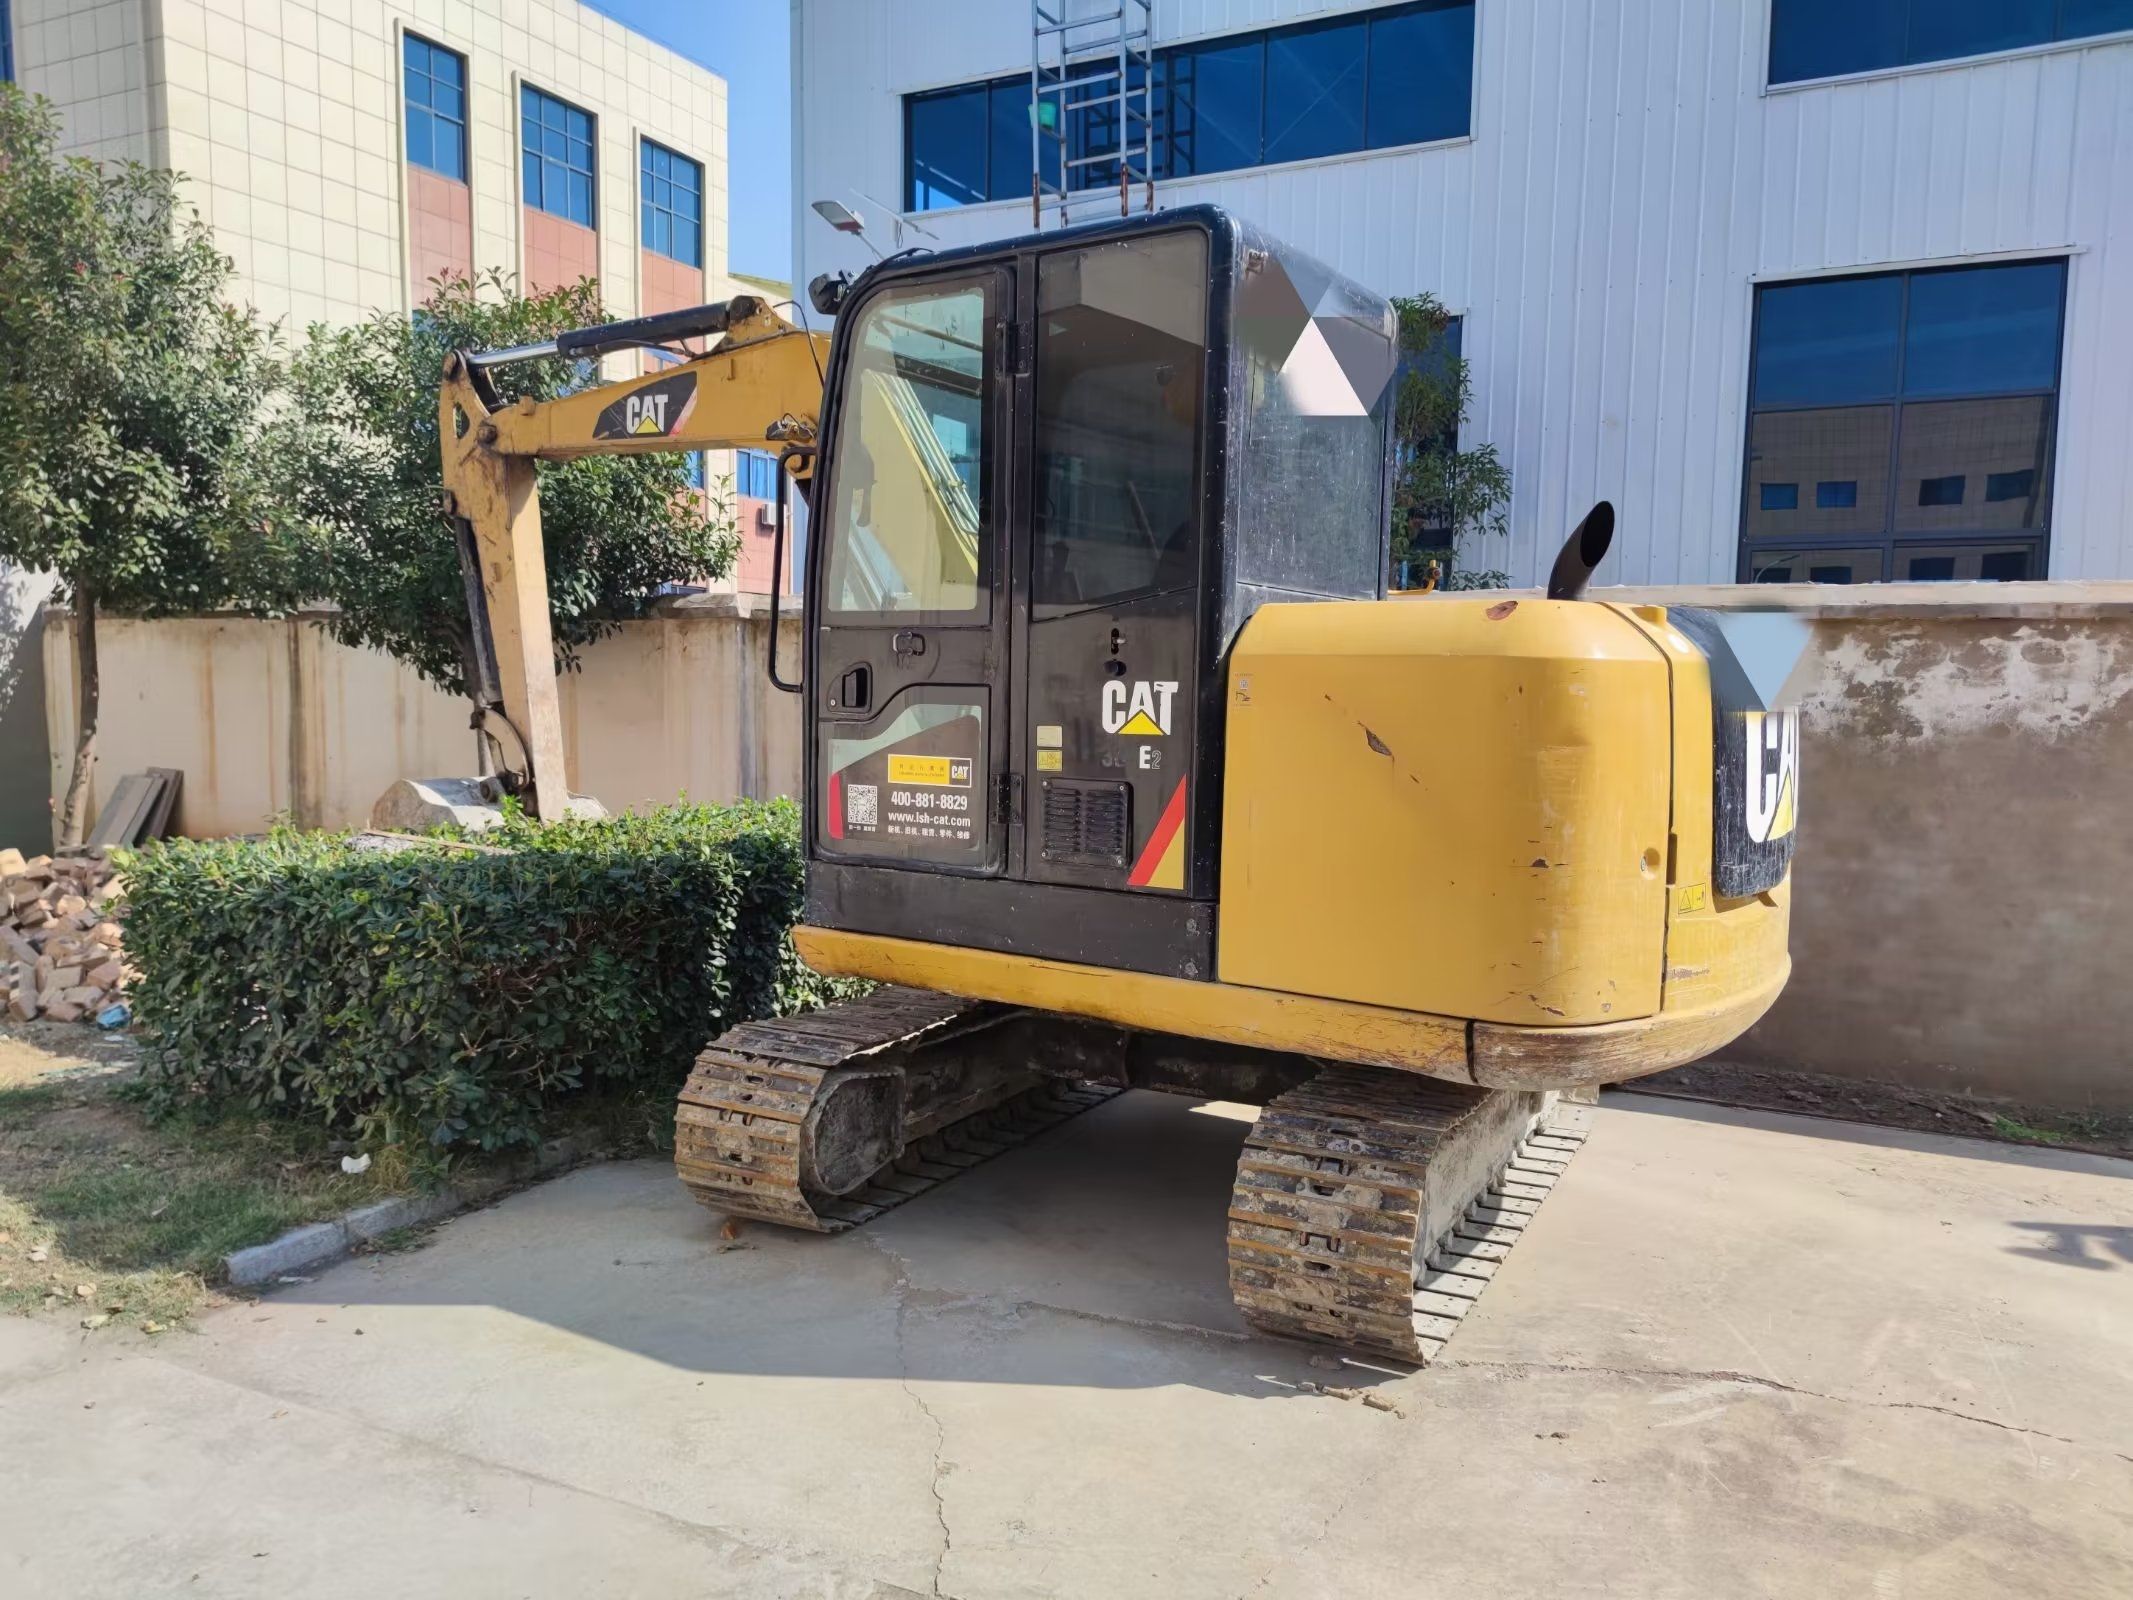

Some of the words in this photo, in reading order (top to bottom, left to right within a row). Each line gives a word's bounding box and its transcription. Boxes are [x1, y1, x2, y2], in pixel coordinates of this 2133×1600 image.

[626, 395, 668, 434] CAT
[1102, 680, 1178, 735] CAT
[1139, 745, 1162, 769] E2
[951, 765, 969, 779] CAT
[891, 791, 967, 810] 400-881-8829
[887, 811, 971, 827] www.lsh-cat.com
